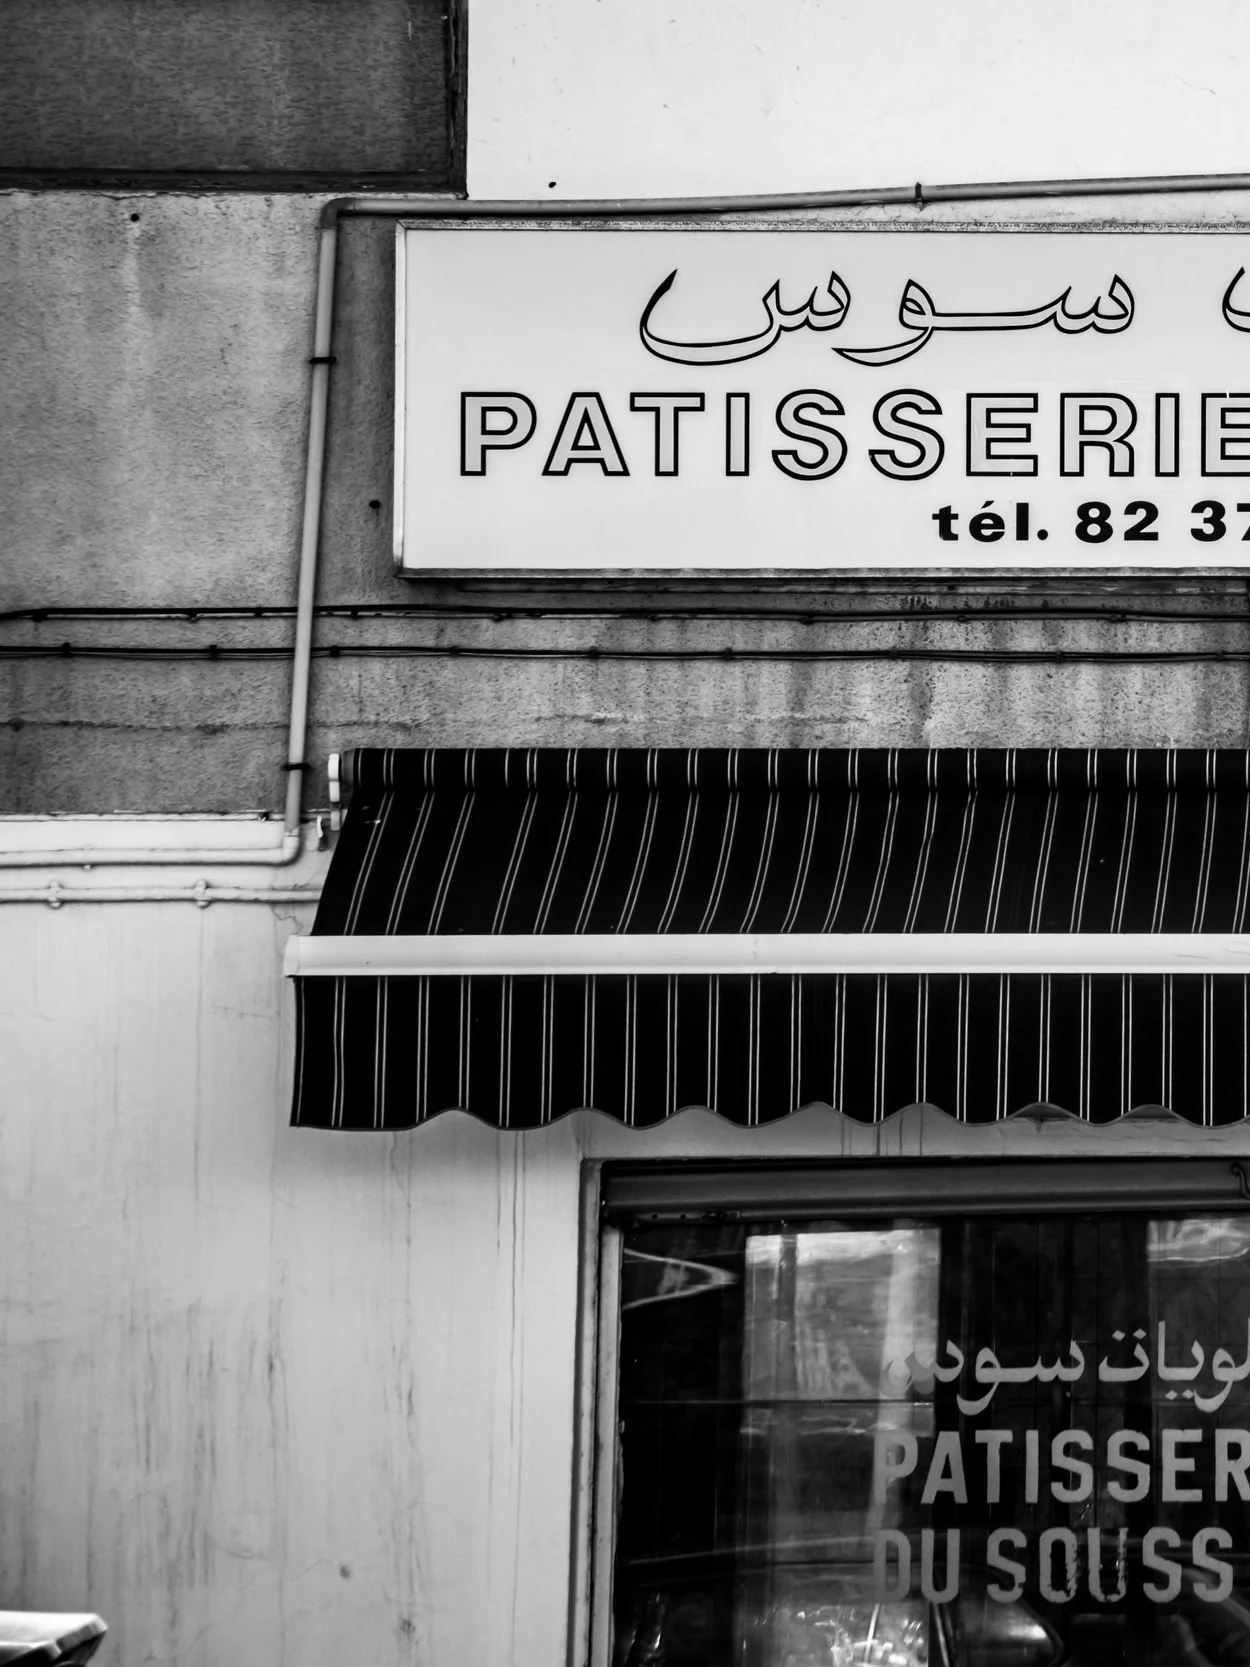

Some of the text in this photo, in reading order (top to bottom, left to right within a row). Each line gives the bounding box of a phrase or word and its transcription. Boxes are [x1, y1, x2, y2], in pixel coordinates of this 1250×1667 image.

[640, 269, 1134, 367] سوس
[932, 501, 1048, 543] tél.
[1075, 501, 1158, 543] 82
[873, 1527, 1233, 1603] DU SOUSS
